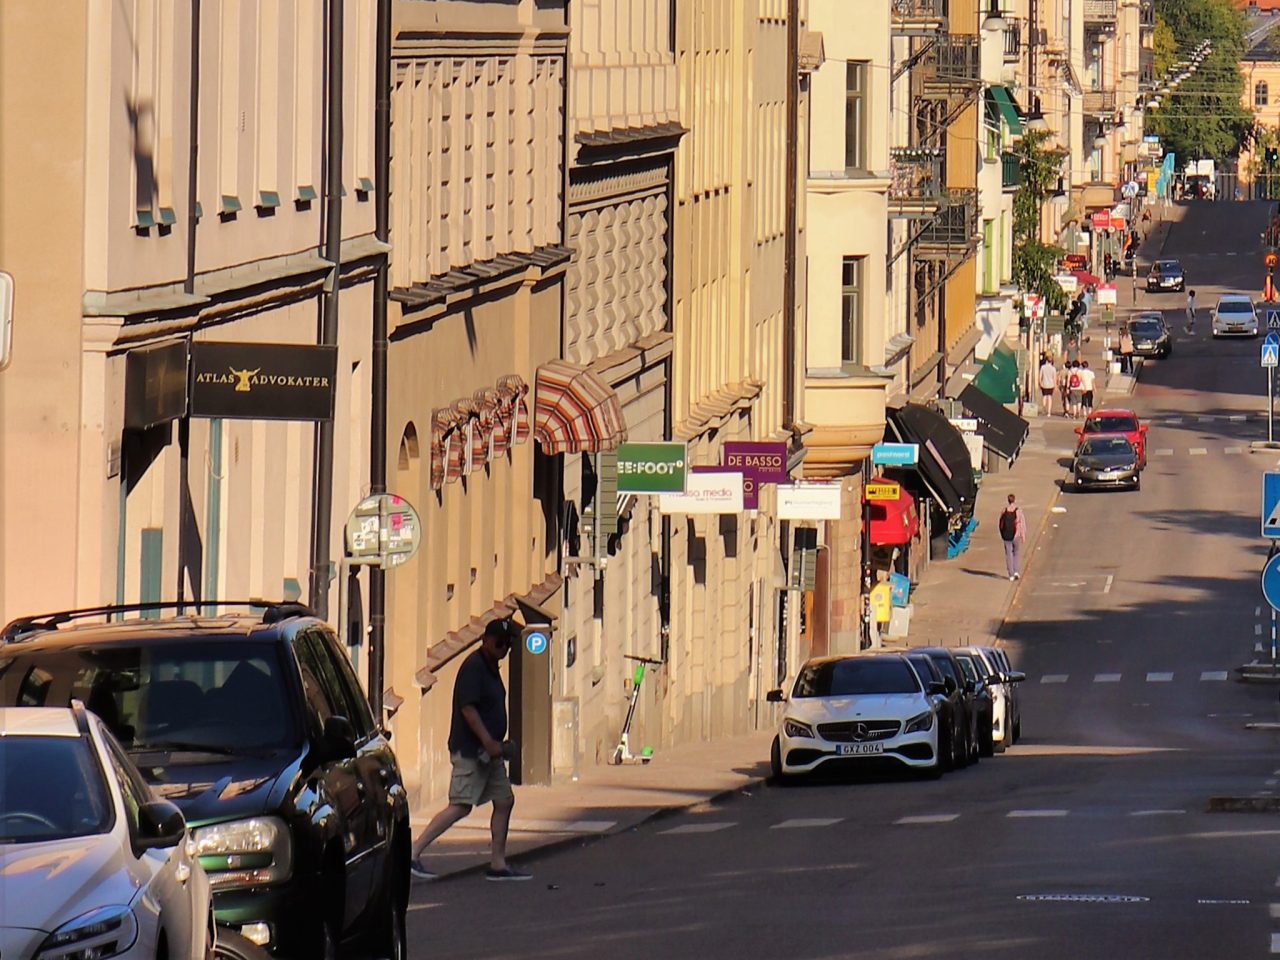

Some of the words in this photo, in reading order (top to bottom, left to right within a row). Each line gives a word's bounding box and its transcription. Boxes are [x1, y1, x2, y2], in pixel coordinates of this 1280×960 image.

[196, 373, 235, 384] ATLAS
[251, 375, 329, 387] ADVOKATER
[728, 455, 742, 467] DE
[745, 455, 782, 467] BASSO
[703, 487, 732, 497] media
